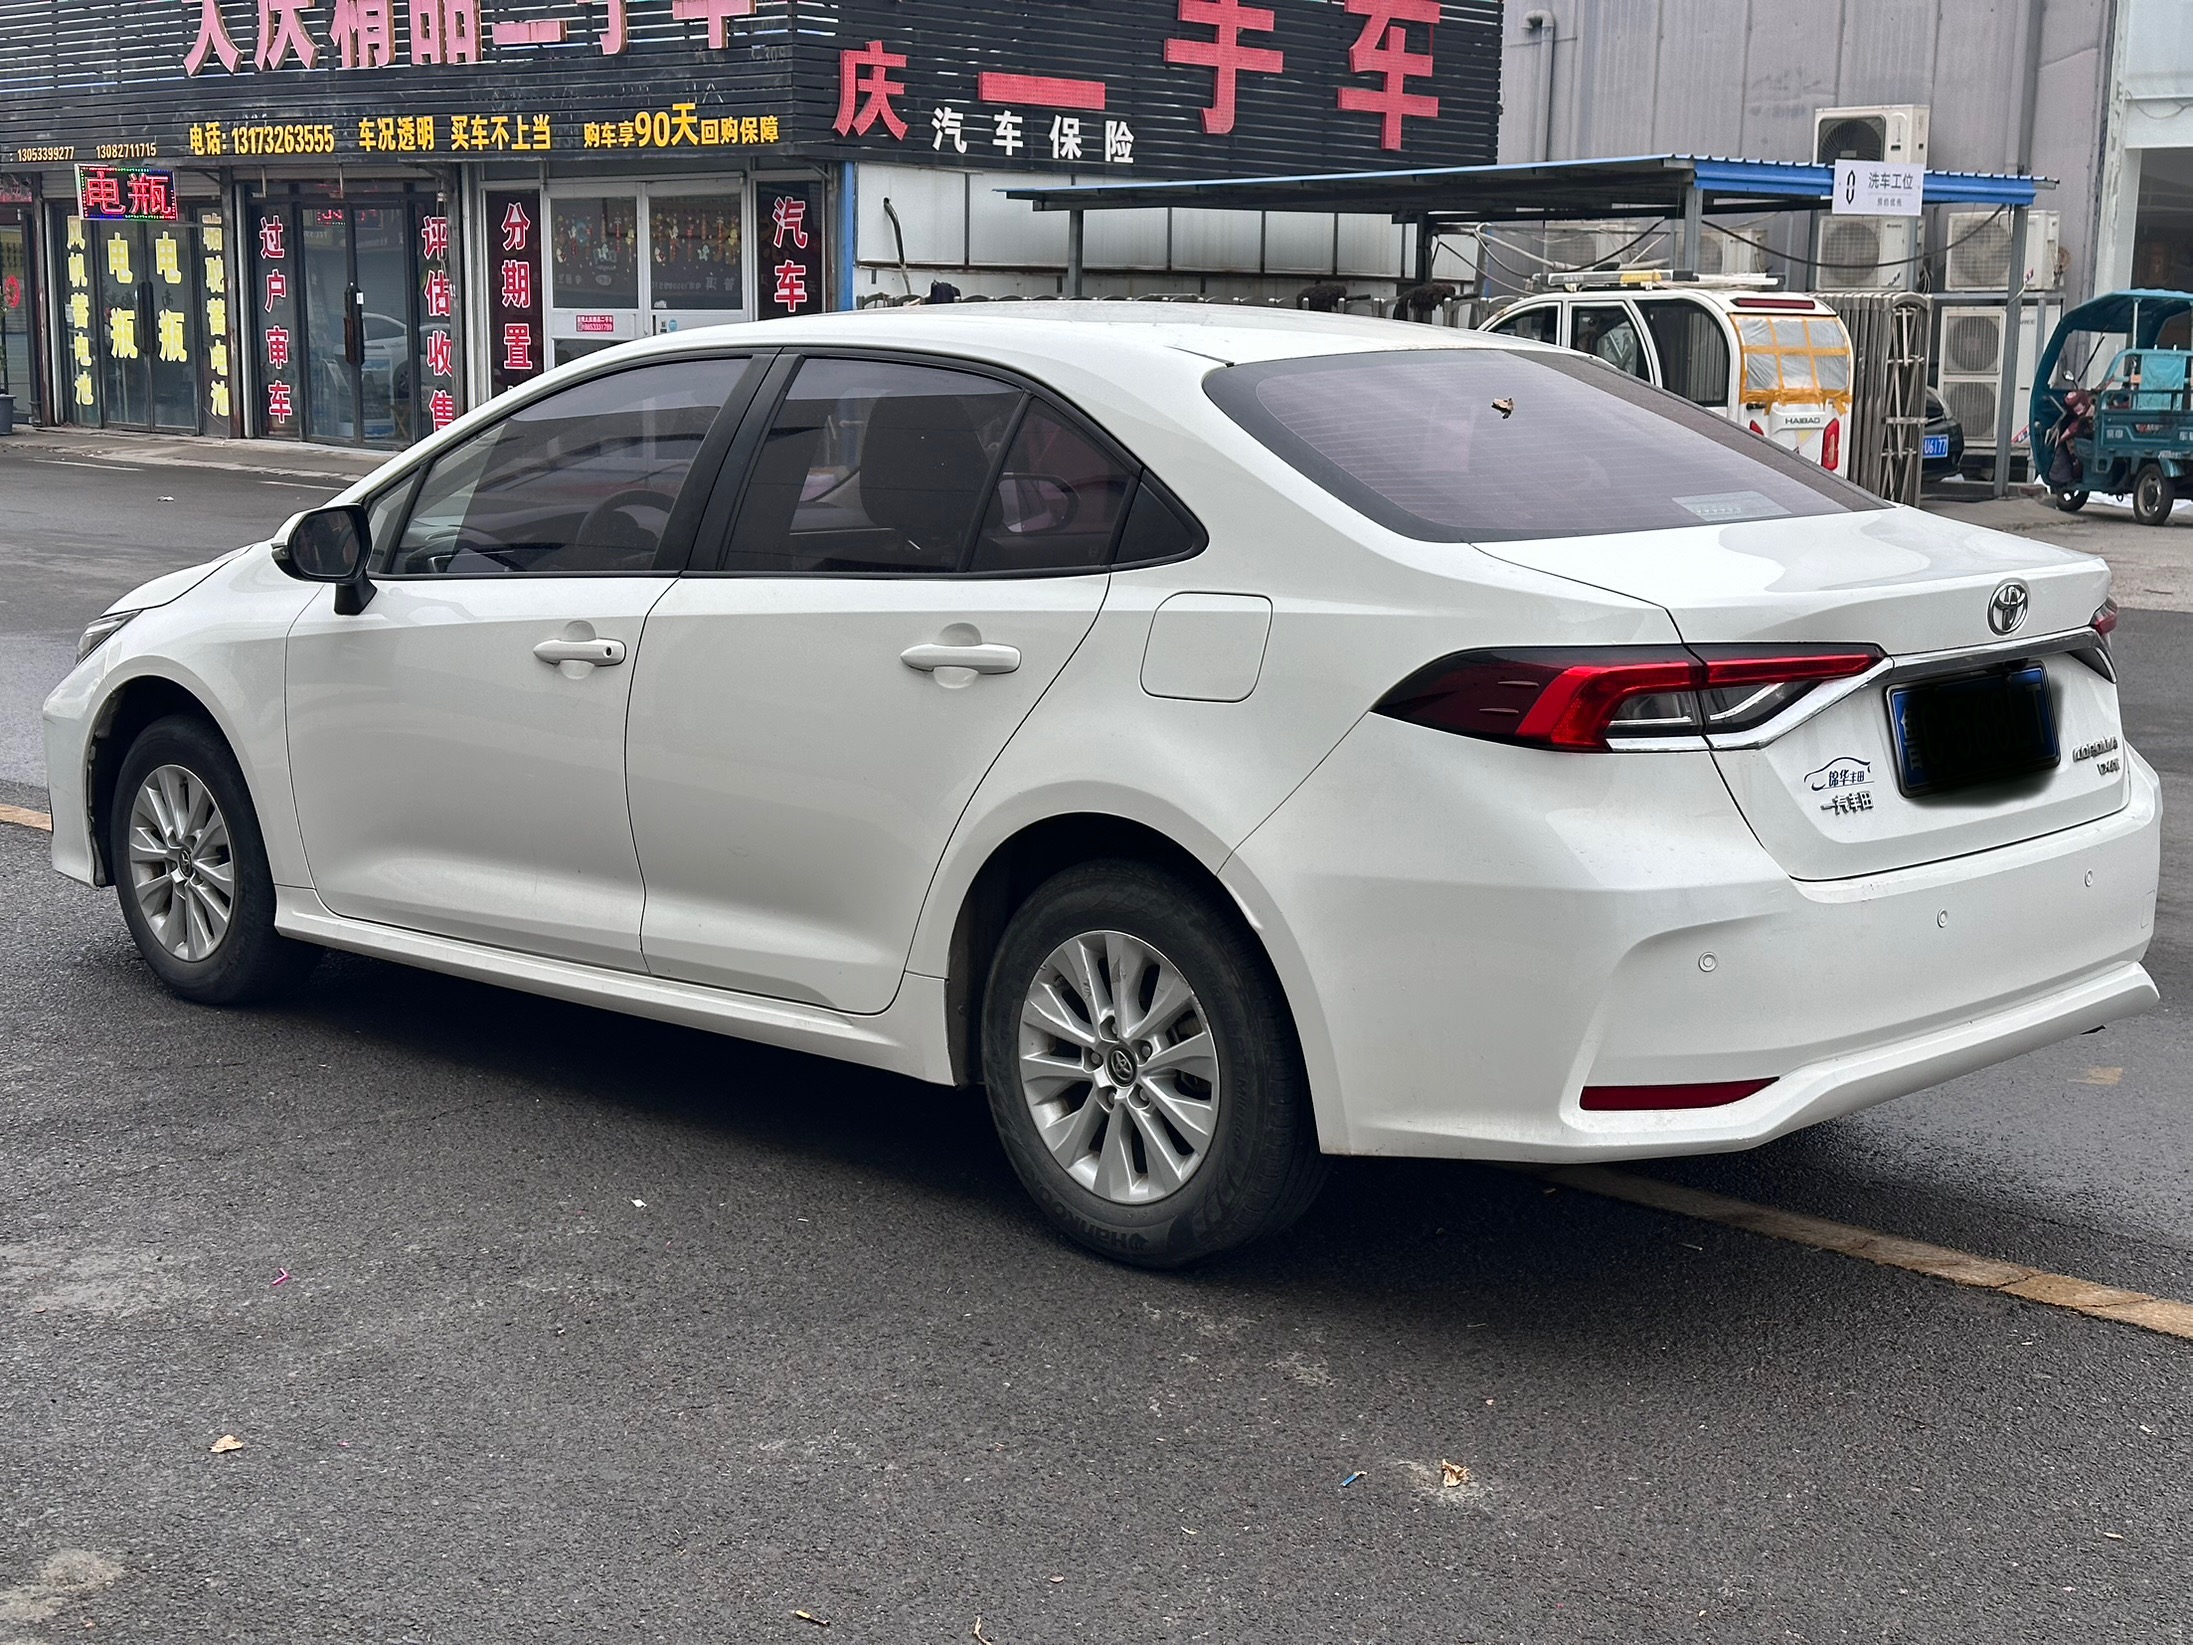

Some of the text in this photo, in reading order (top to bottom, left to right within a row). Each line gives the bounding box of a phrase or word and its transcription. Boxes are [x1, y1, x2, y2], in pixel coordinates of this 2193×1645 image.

[189, 116, 435, 155] 电话: 13173263555 车况透明
[451, 114, 551, 150] 买车不上当
[584, 102, 779, 148] 购车享90天回购保障
[931, 107, 1135, 164] 汽车保险
[17, 143, 157, 162] 13053399277 13082711715
[85, 170, 172, 215] 电瓶
[1868, 171, 1914, 190] 洗车工位
[772, 196, 808, 312] 汽车
[108, 232, 139, 359] 电瓶
[155, 231, 187, 362] 电瓶
[259, 215, 293, 424] 过户审车
[501, 202, 533, 391] 分期置
[421, 215, 454, 433] 评估收售
[1819, 790, 1874, 816] 一汽丰田
